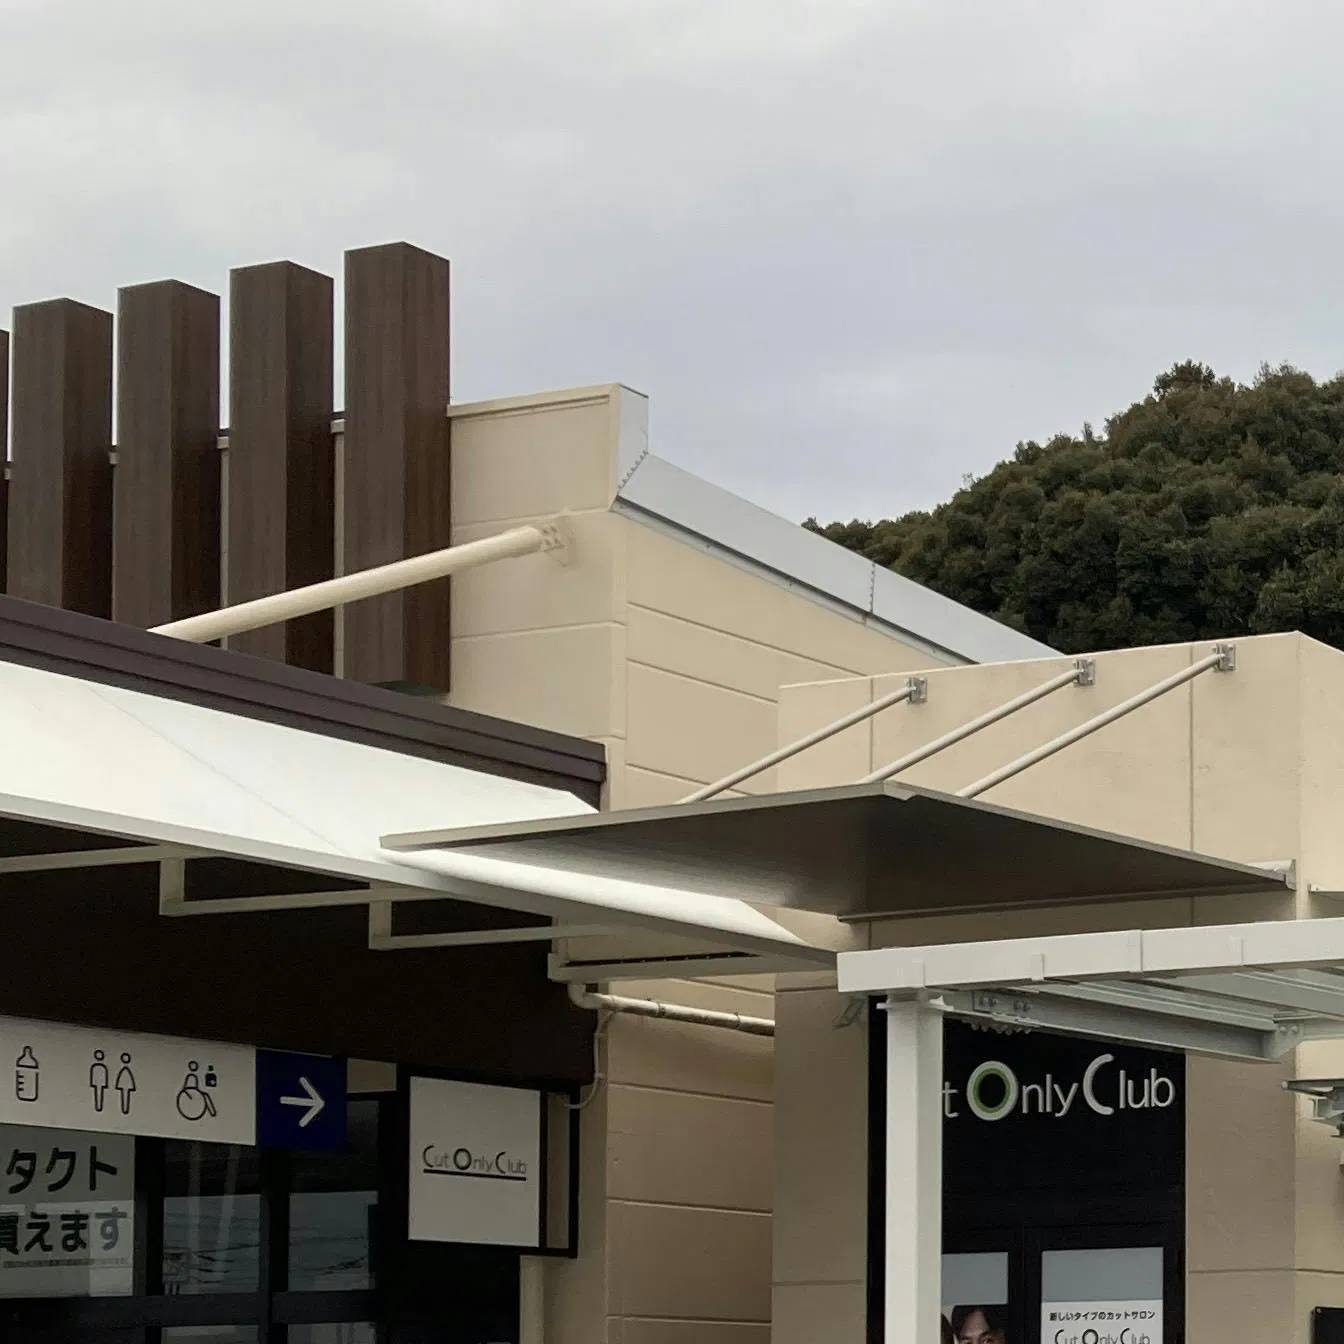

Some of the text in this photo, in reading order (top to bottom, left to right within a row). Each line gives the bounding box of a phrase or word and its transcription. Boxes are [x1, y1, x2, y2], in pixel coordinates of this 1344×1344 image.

[966, 1060, 1079, 1121] Only
[1083, 1053, 1176, 1115] Club
[6, 1145, 118, 1194] タクト
[422, 1144, 528, 1174] Cut Only Club
